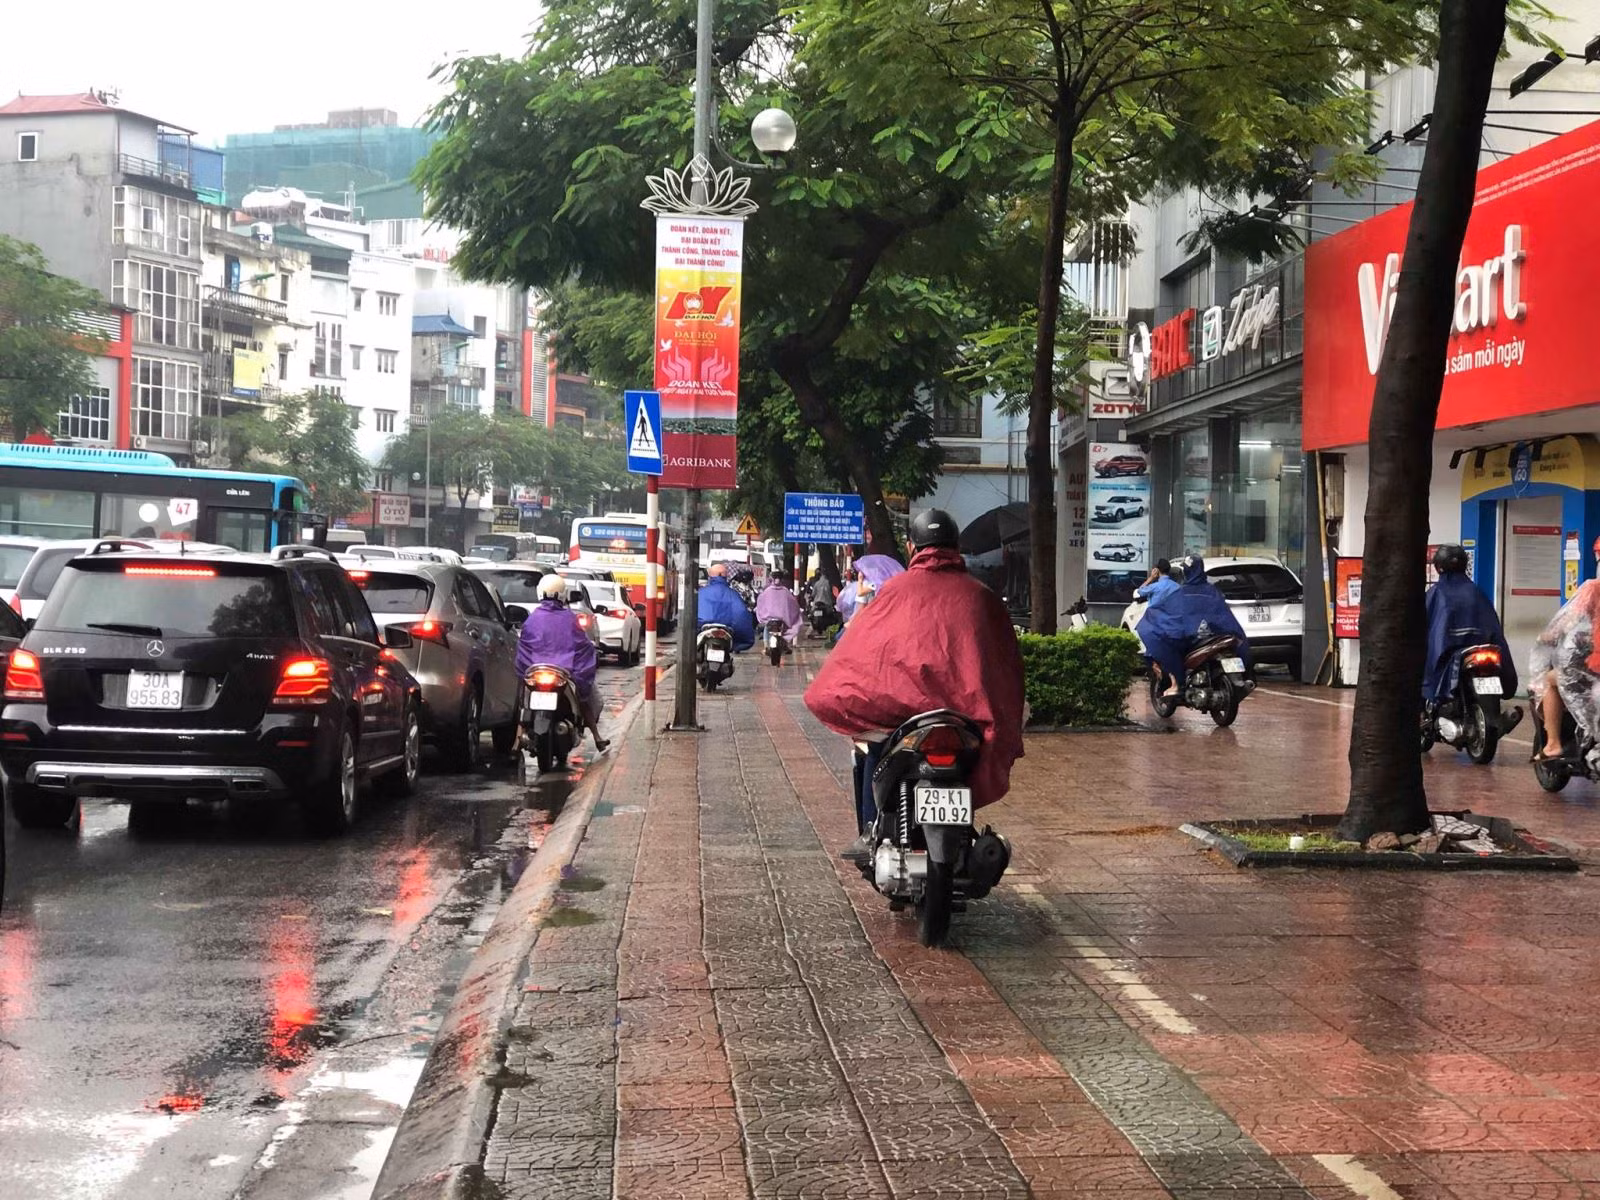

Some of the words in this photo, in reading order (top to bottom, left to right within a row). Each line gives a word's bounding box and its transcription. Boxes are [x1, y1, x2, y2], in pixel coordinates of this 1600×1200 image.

[1151, 308, 1197, 381] BAIC
[1497, 336, 1525, 368] ngày
[1093, 404, 1146, 414] ZOTYE
[670, 457, 732, 468] AGRIBANK
[176, 503, 190, 515] 47
[804, 497, 828, 507] THÔNG
[830, 497, 844, 508] BÁO
[143, 672, 170, 688] 30A
[130, 690, 180, 706] 955.83
[924, 790, 962, 805] 29-K1
[920, 807, 968, 822] 210.92
